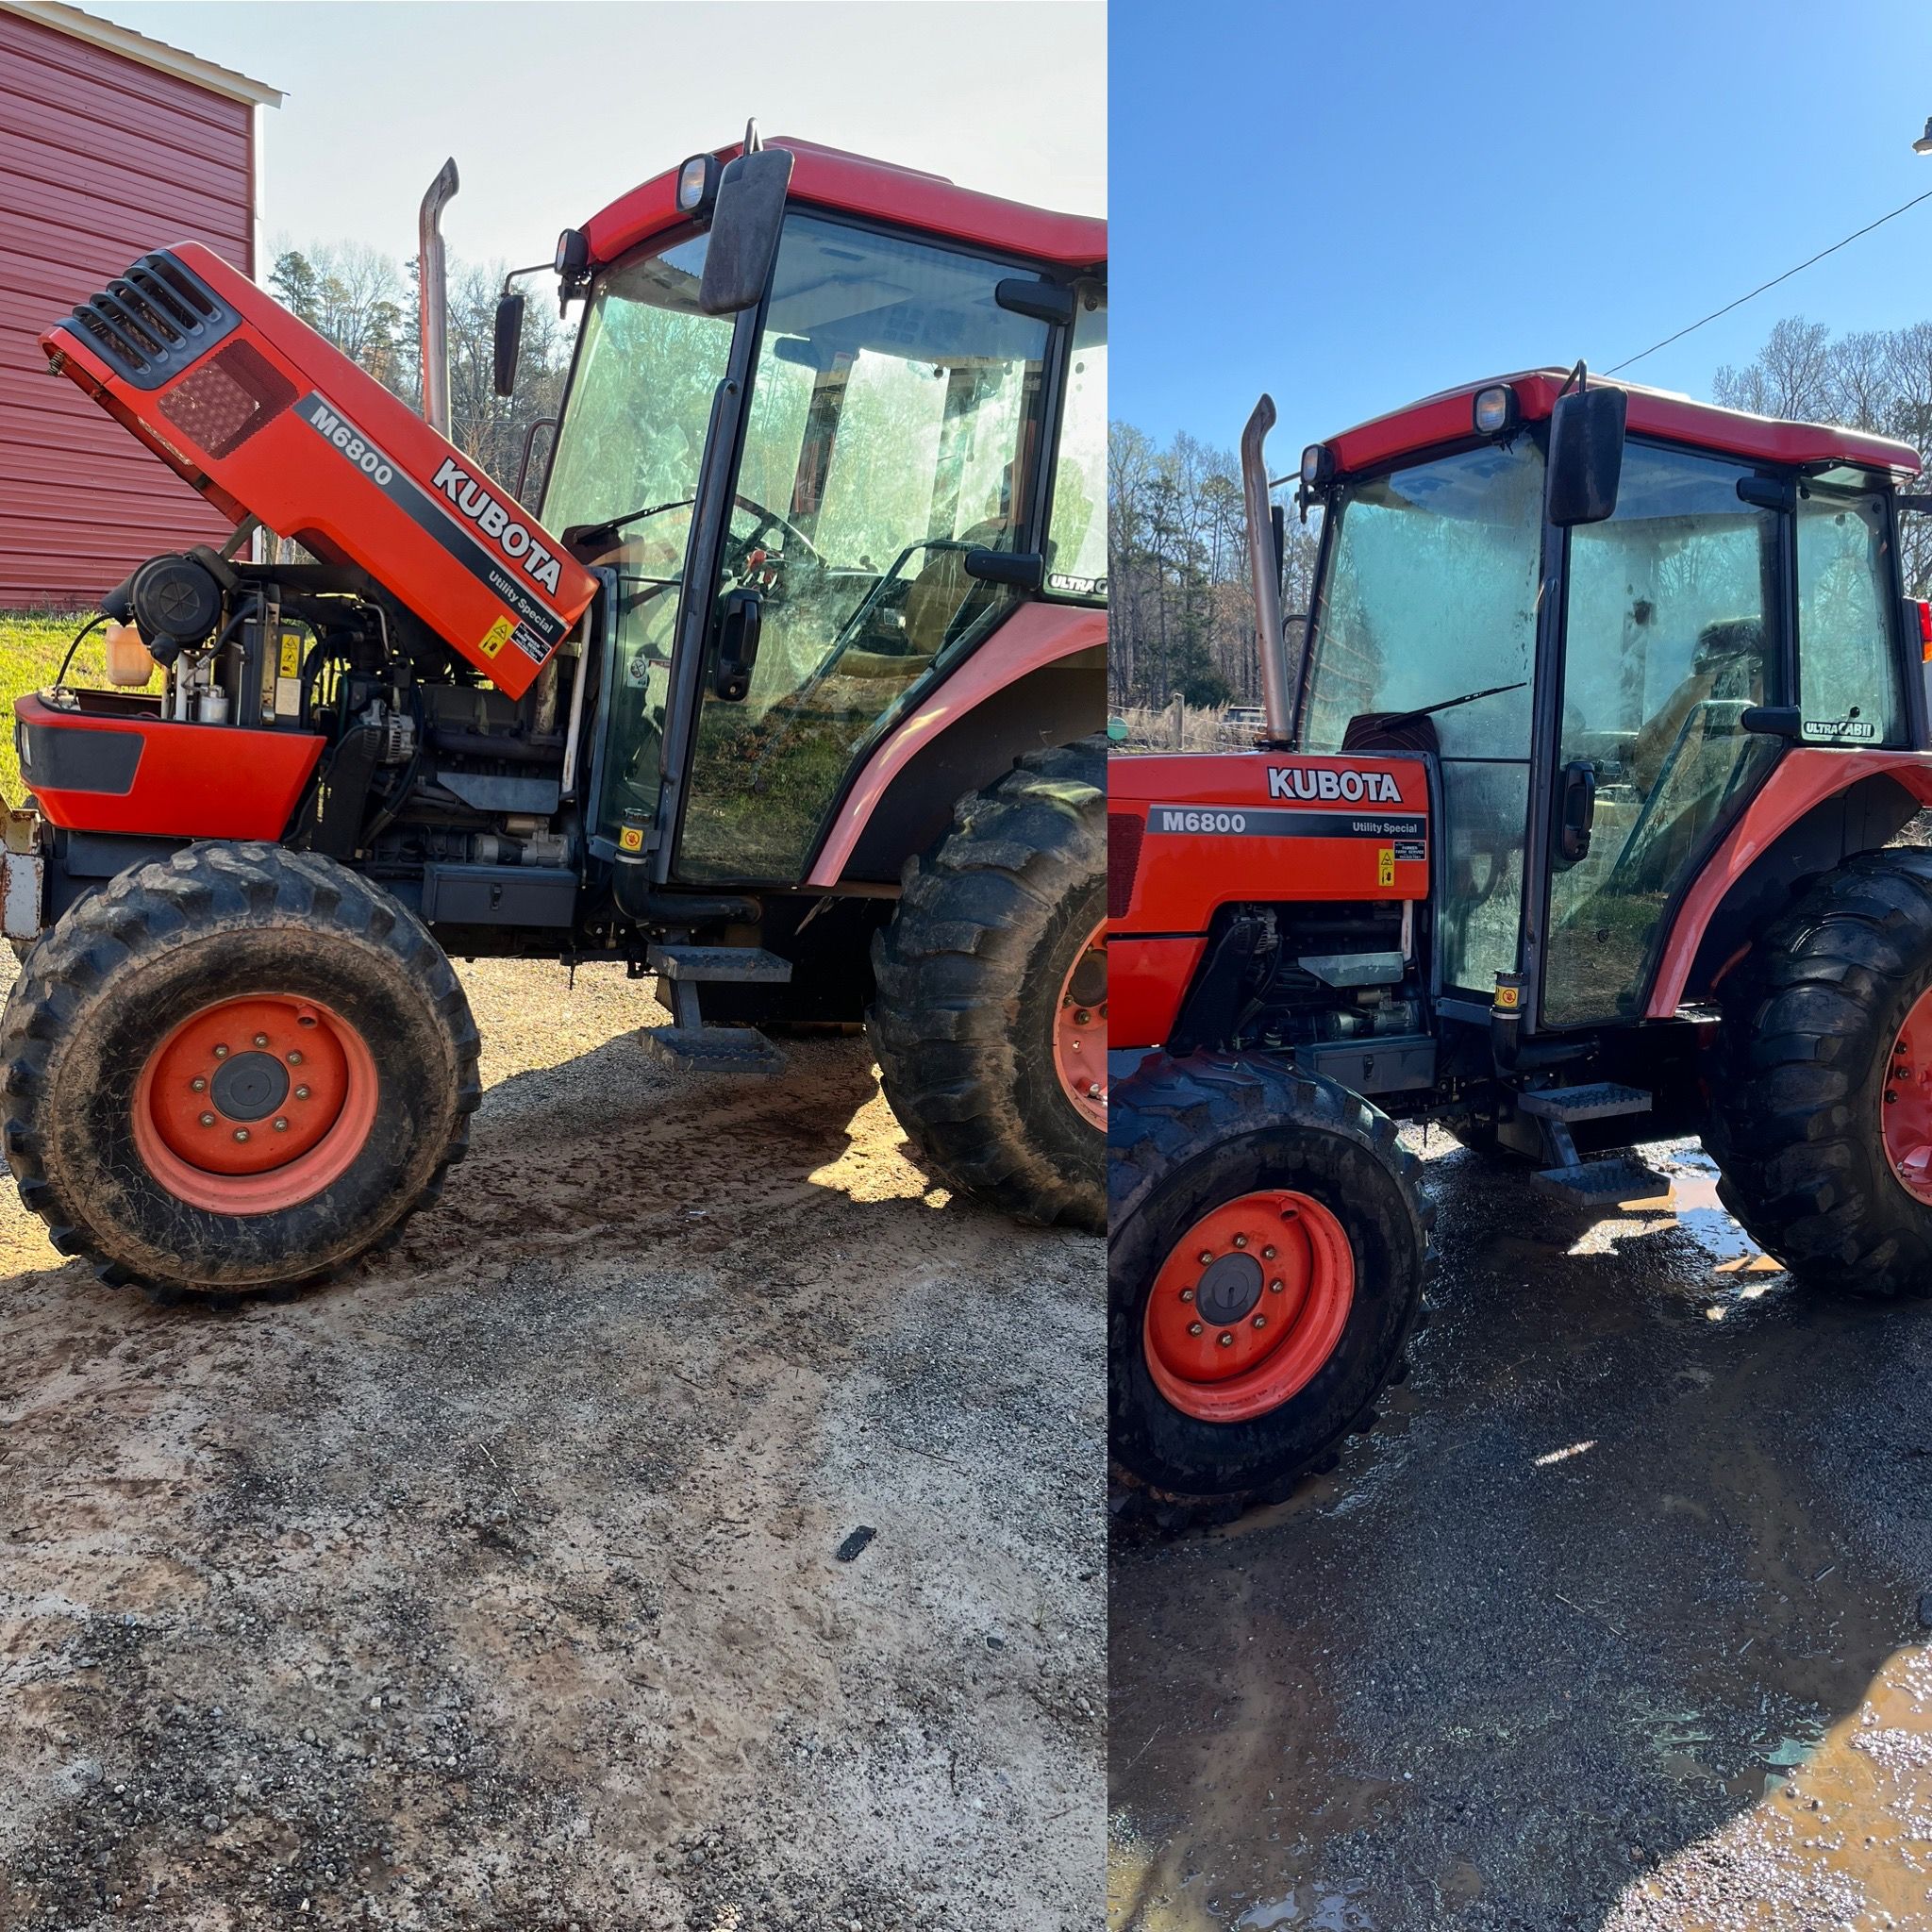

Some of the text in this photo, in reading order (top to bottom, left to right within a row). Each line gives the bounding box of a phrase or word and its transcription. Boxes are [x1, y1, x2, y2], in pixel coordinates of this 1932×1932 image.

[310, 406, 392, 485] M6800
[431, 457, 562, 596] KUBOTA
[489, 571, 554, 633] Utility Special
[1268, 767, 1403, 802] KUBOTA
[1162, 811, 1245, 832] M6800
[1353, 822, 1417, 834] Utility Special
